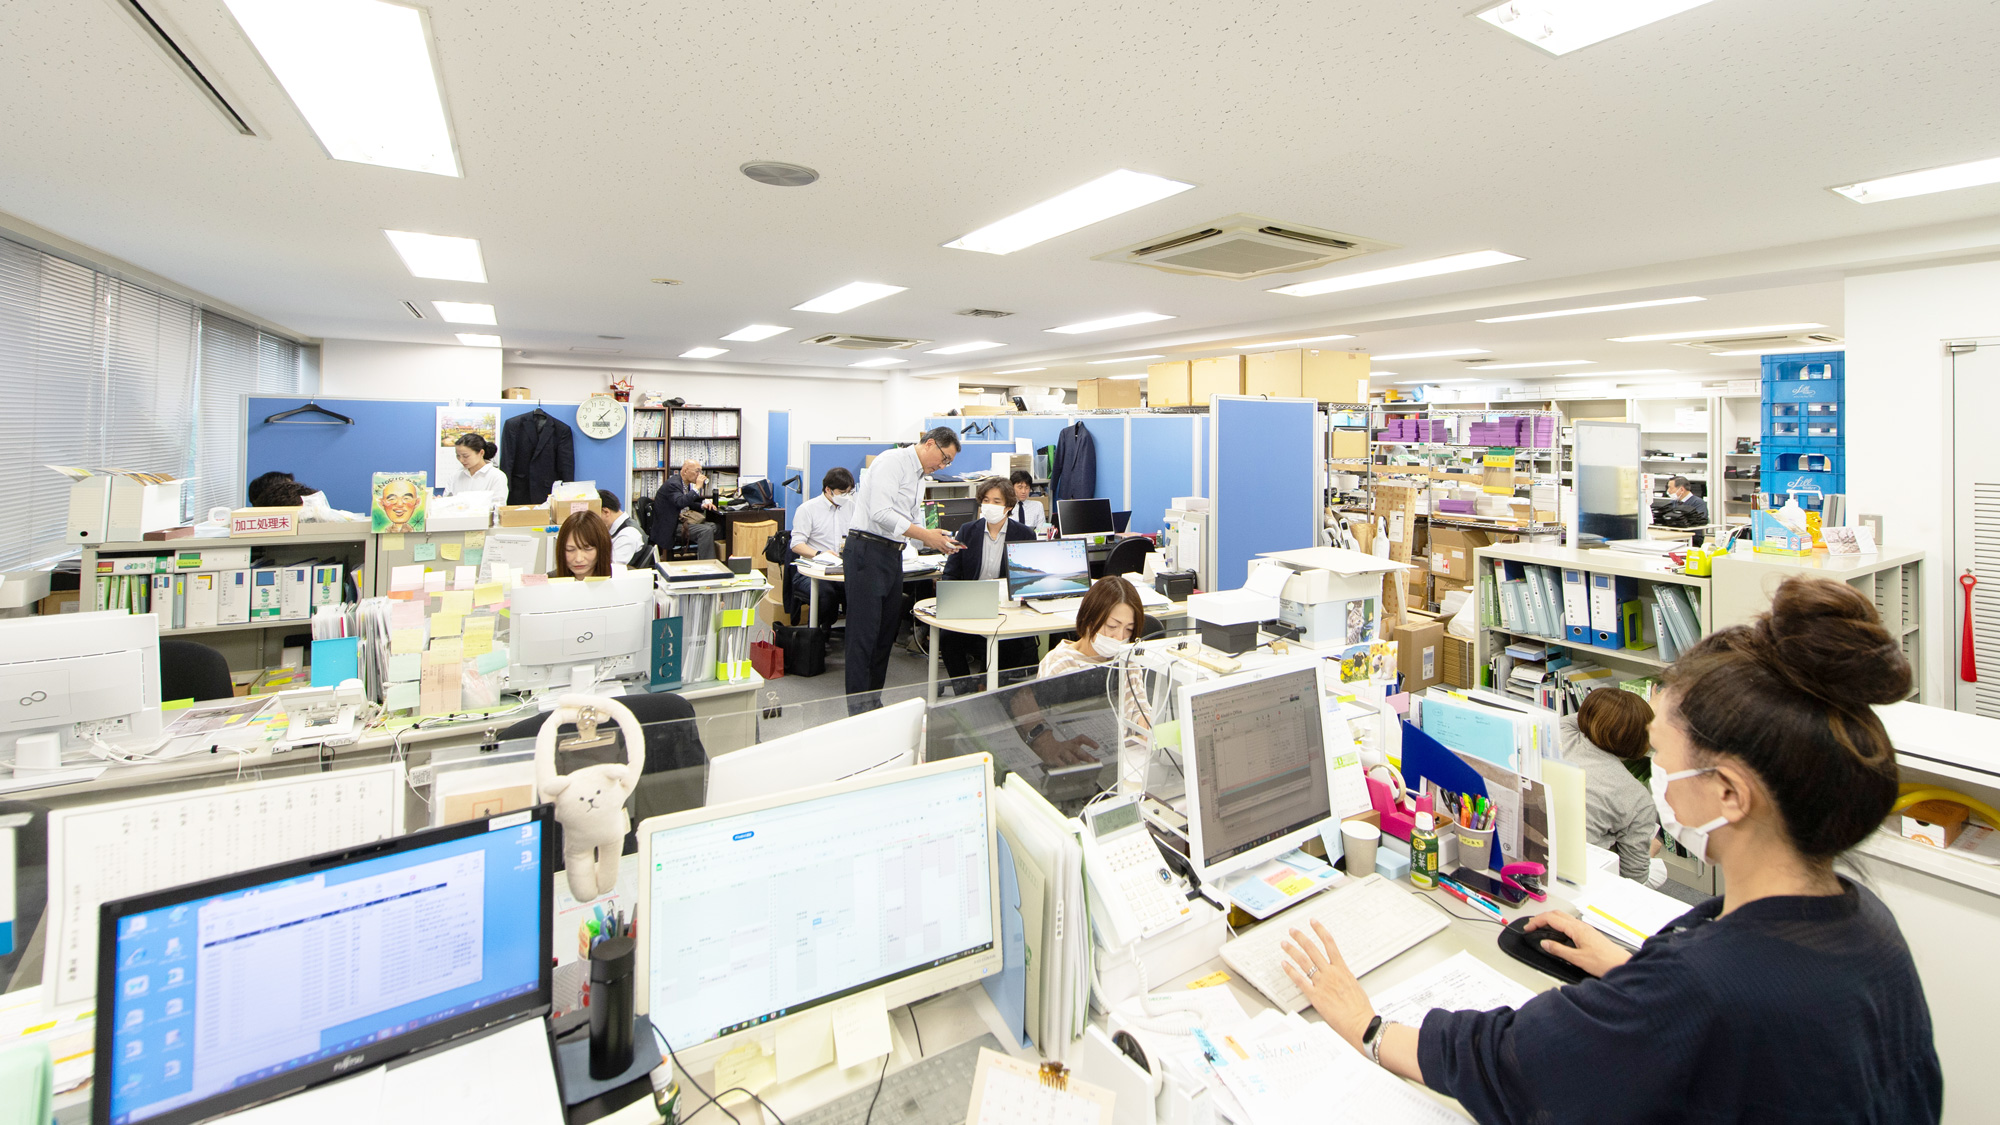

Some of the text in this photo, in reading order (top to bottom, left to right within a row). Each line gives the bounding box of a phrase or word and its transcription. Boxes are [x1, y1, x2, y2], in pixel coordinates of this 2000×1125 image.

[235, 516, 290, 532] 加工処理未
